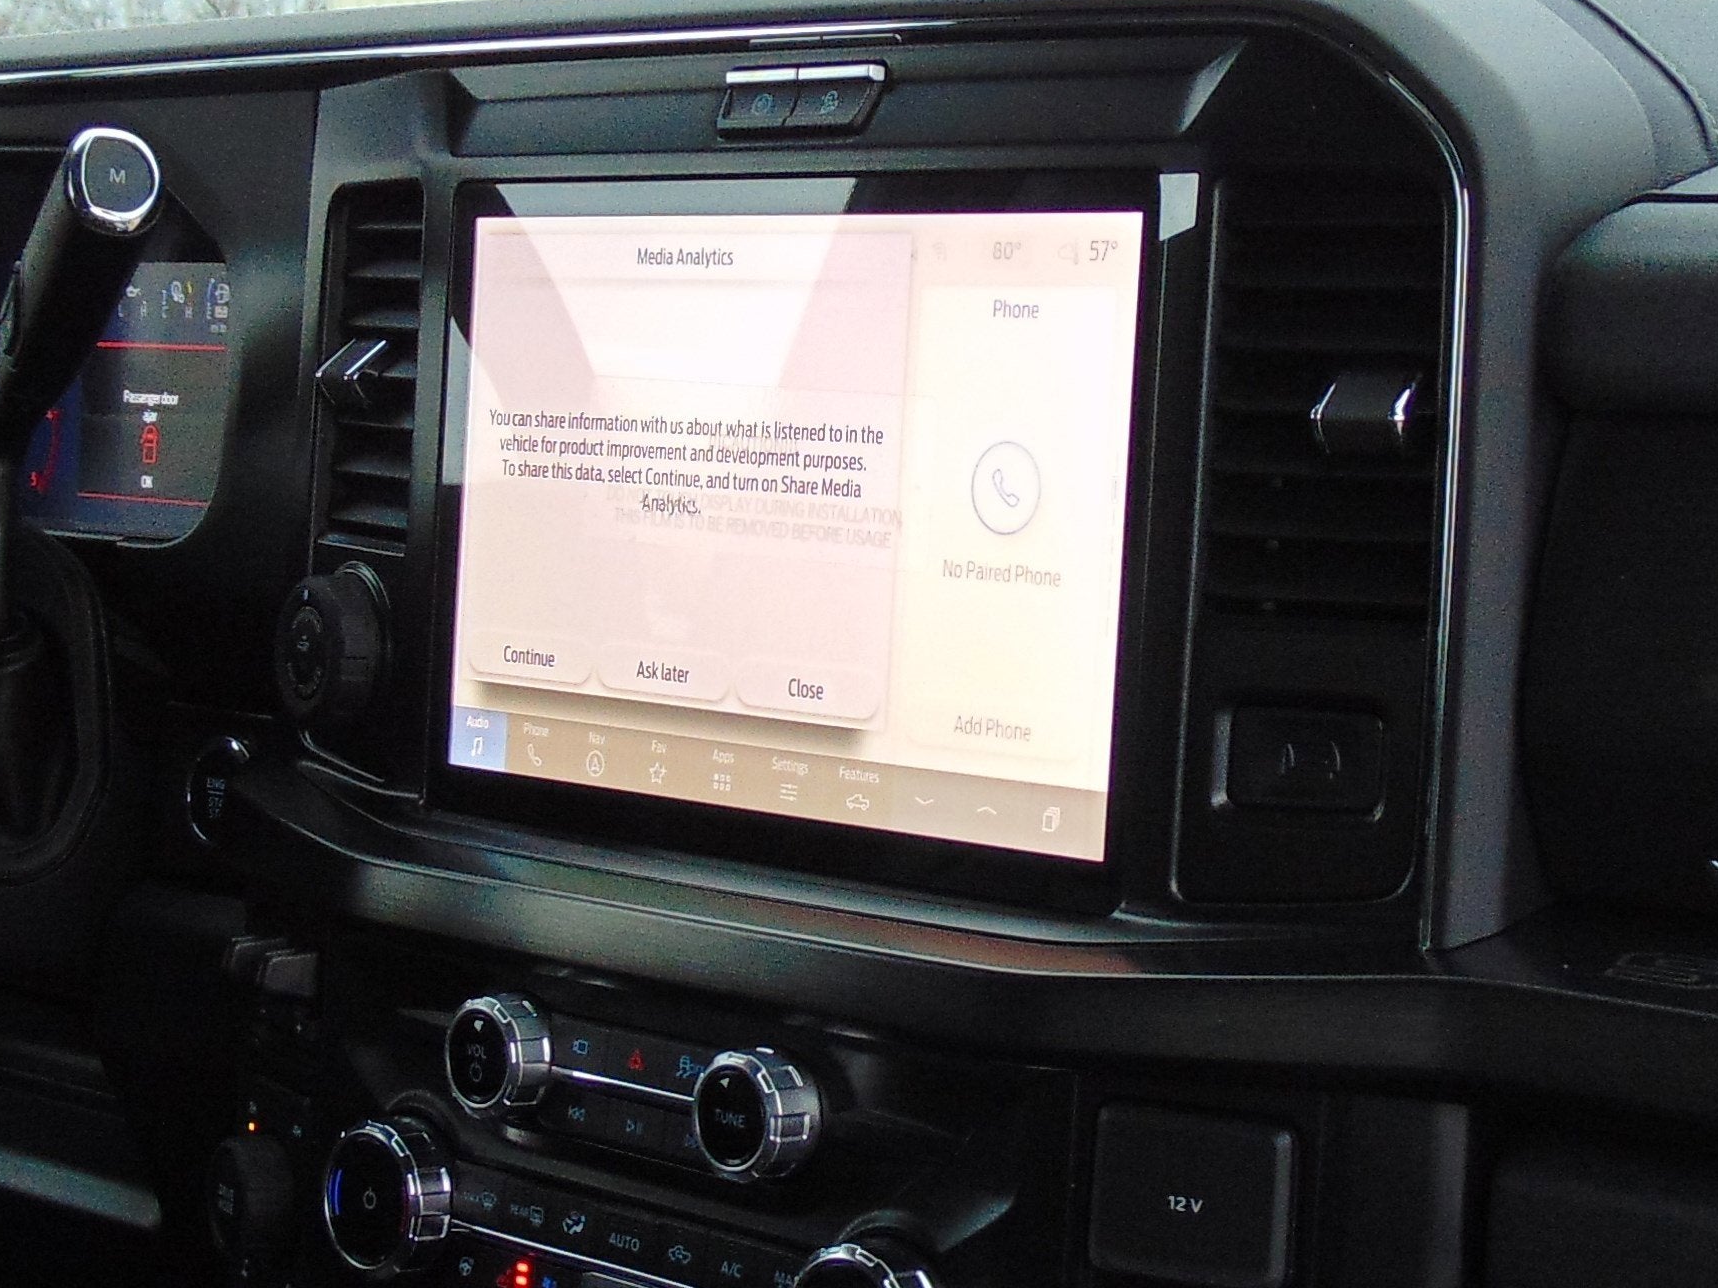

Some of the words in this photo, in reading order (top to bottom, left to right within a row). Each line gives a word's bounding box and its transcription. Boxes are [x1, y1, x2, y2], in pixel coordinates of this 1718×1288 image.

[108, 166, 126, 184] M
[636, 247, 673, 266] Media
[676, 246, 734, 270] Analytics
[1088, 239, 1119, 262] 57°
[992, 298, 1040, 319] Phone
[489, 409, 511, 427] You
[512, 413, 533, 428] can
[535, 410, 566, 430] share
[568, 412, 638, 433] information
[641, 415, 668, 434] with
[670, 421, 684, 436] us
[686, 417, 721, 437] about
[726, 419, 758, 439] what
[762, 420, 772, 440] is
[774, 420, 827, 442] listened
[829, 425, 843, 443] to
[845, 425, 858, 445] in
[860, 425, 884, 446] the
[499, 433, 539, 453] vehicle
[541, 436, 558, 454] for
[559, 437, 605, 458] product
[607, 440, 686, 462] improvement
[690, 444, 714, 463] and
[716, 447, 801, 469] development
[803, 453, 868, 472] purposes.
[502, 458, 516, 477] To
[518, 459, 550, 479] share
[551, 461, 573, 481] this
[575, 463, 606, 484] data,
[607, 466, 643, 486] select
[644, 467, 703, 491] Continue,
[706, 472, 730, 491] and
[732, 473, 759, 492] turn
[761, 477, 778, 494] on
[780, 475, 819, 496] Share
[821, 478, 863, 499] Media
[640, 492, 702, 516] Analytics.
[942, 558, 963, 580] No
[965, 559, 1013, 584] Paired
[1014, 564, 1062, 588] Phone
[502, 644, 555, 669] Continue
[636, 660, 659, 680] Ask
[659, 662, 690, 685] later
[787, 677, 824, 701] Close
[953, 714, 983, 736] Add
[984, 717, 1032, 743] Phone
[712, 748, 736, 765] Apps
[771, 756, 810, 776] Settings
[838, 765, 880, 786] Features
[608, 1232, 641, 1252] AUTO
[721, 1259, 743, 1279] A/C
